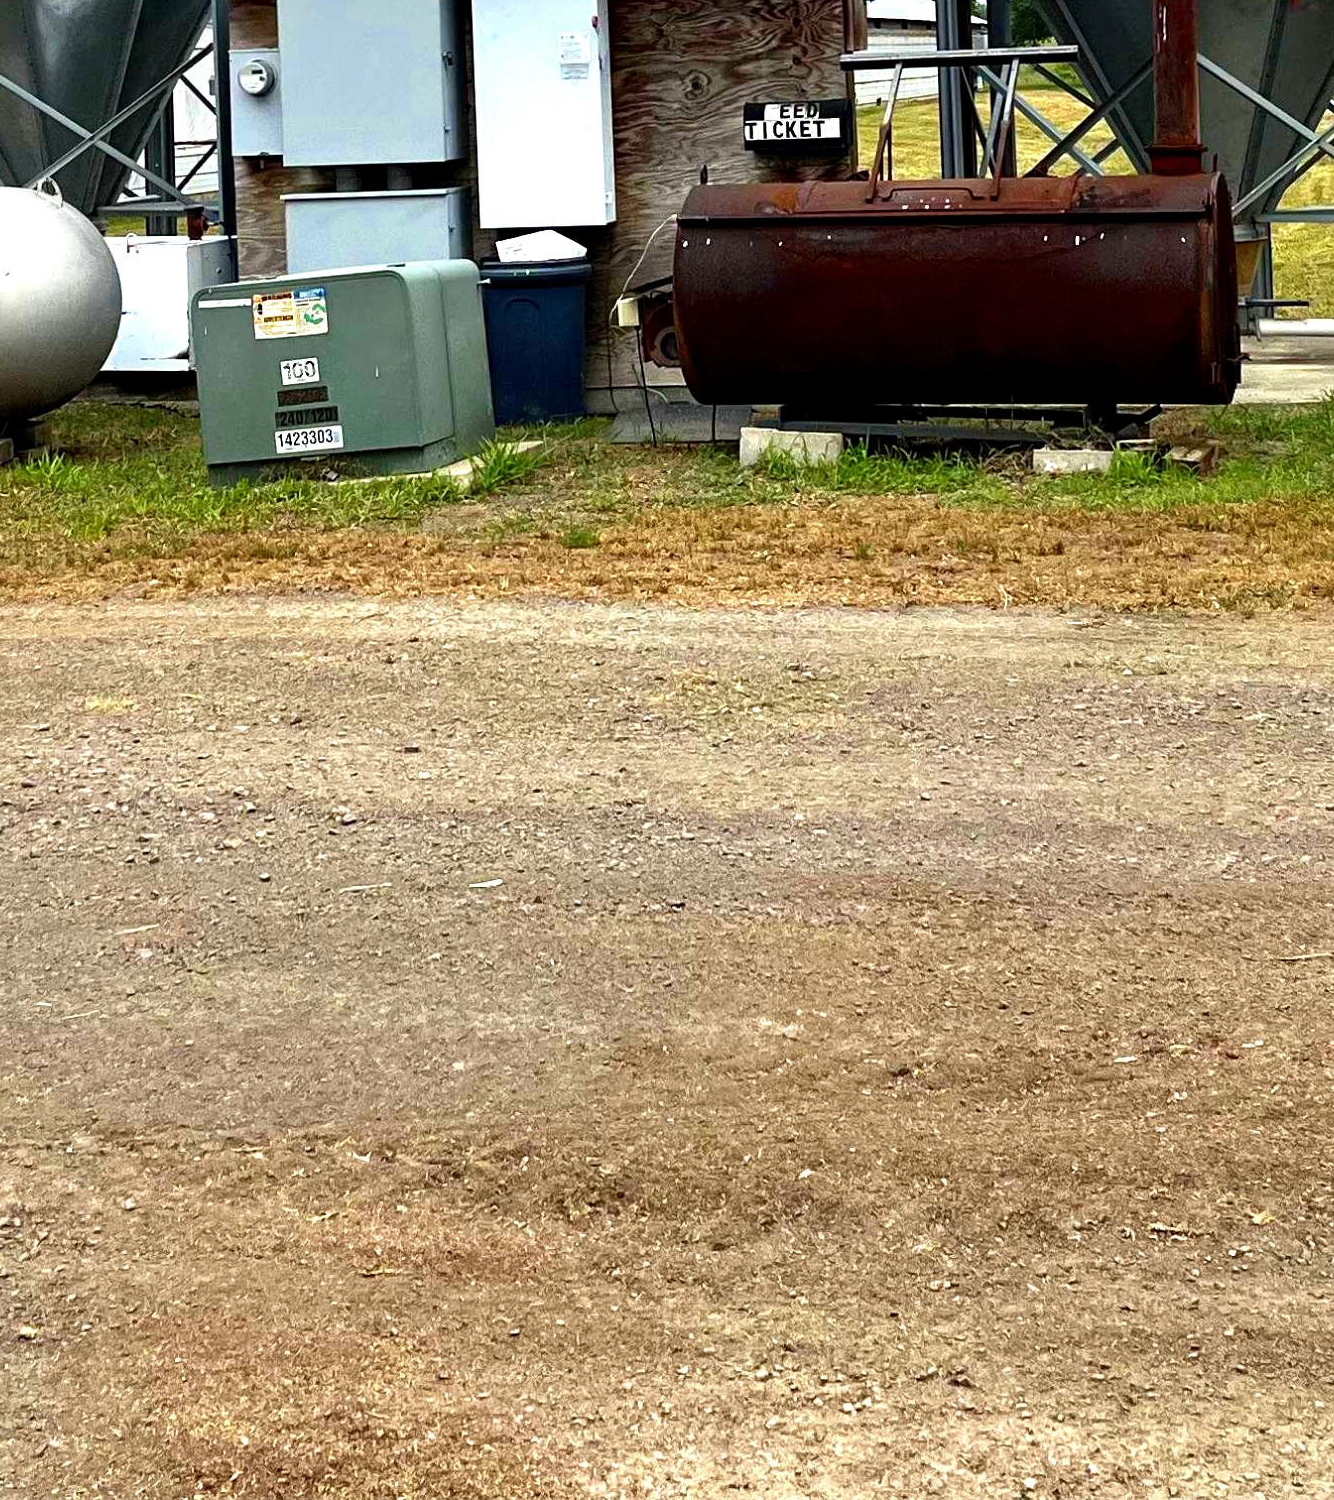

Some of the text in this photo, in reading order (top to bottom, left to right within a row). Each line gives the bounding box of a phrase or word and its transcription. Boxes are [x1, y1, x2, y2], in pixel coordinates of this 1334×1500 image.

[771, 103, 819, 119] EED
[745, 120, 825, 139] TICKET
[277, 428, 333, 448] 1423303
